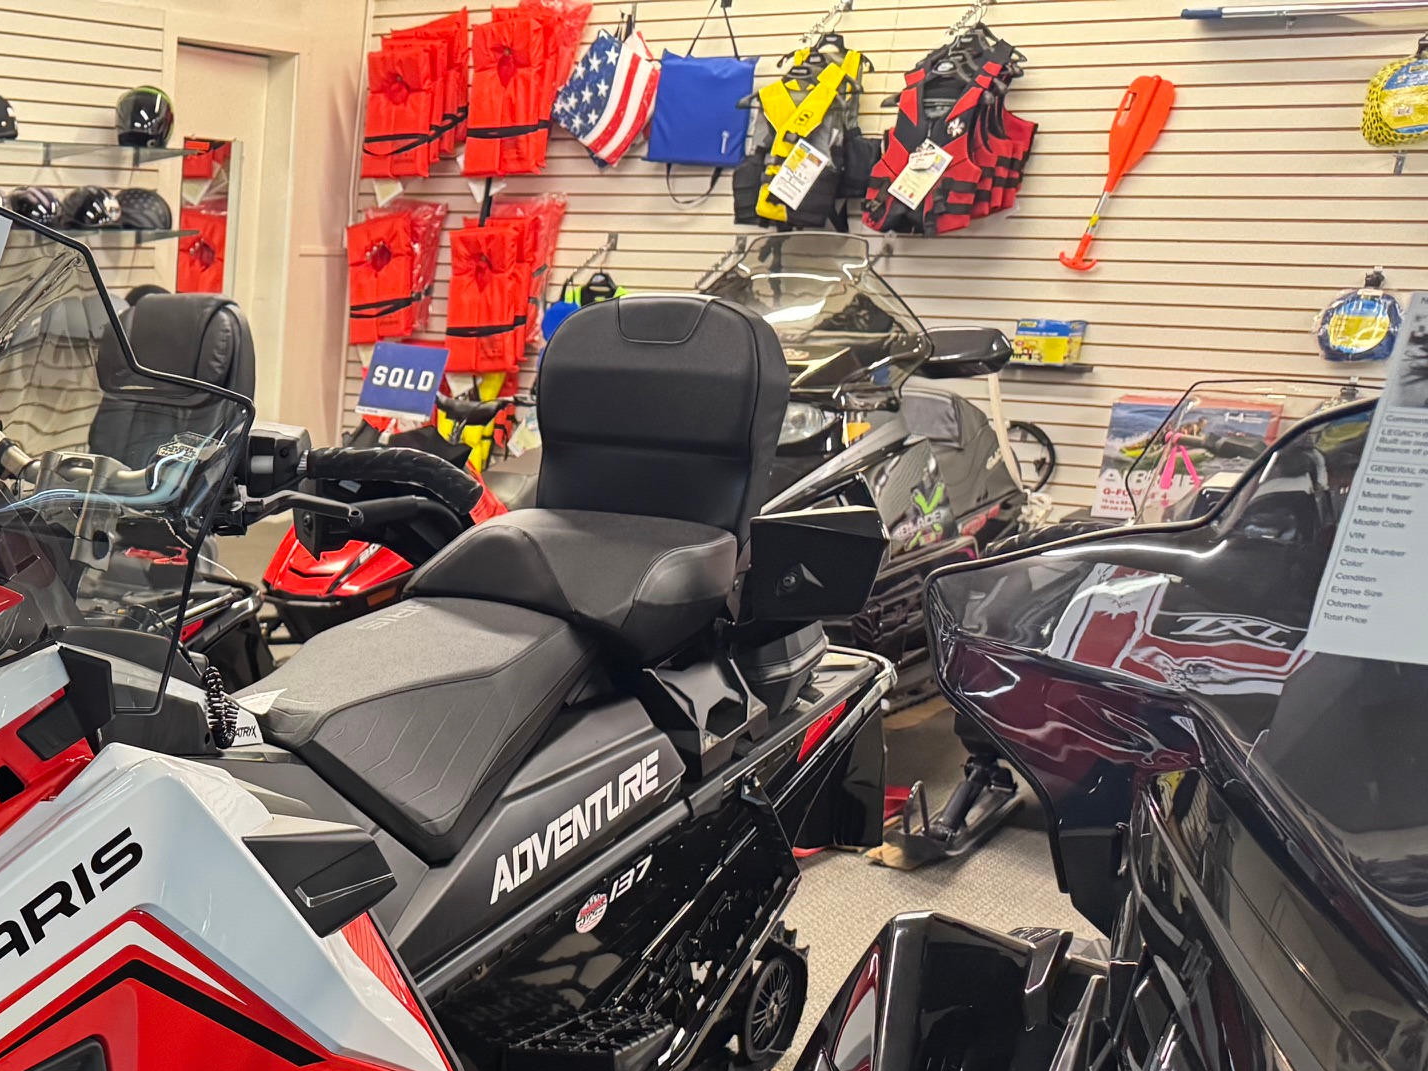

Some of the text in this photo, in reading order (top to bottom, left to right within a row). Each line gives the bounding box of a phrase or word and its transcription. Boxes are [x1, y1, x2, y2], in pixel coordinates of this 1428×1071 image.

[372, 365, 435, 392] SOLD
[1370, 464, 1416, 474] GENERAL
[1366, 477, 1424, 488] Manufacturer
[1362, 490, 1411, 500] Model Year
[1357, 504, 1413, 515] Model Name
[1352, 518, 1406, 529] Model Code
[1348, 532, 1366, 540] VIN
[1344, 545, 1406, 557] Stock Number
[1340, 558, 1365, 568] Color
[1335, 572, 1376, 583] Condition
[1330, 586, 1383, 598] Engine Size
[1326, 598, 1370, 610] Odometer
[1323, 612, 1368, 624] Total Price
[490, 749, 660, 905] ADVENTURE
[609, 854, 653, 903] 137
